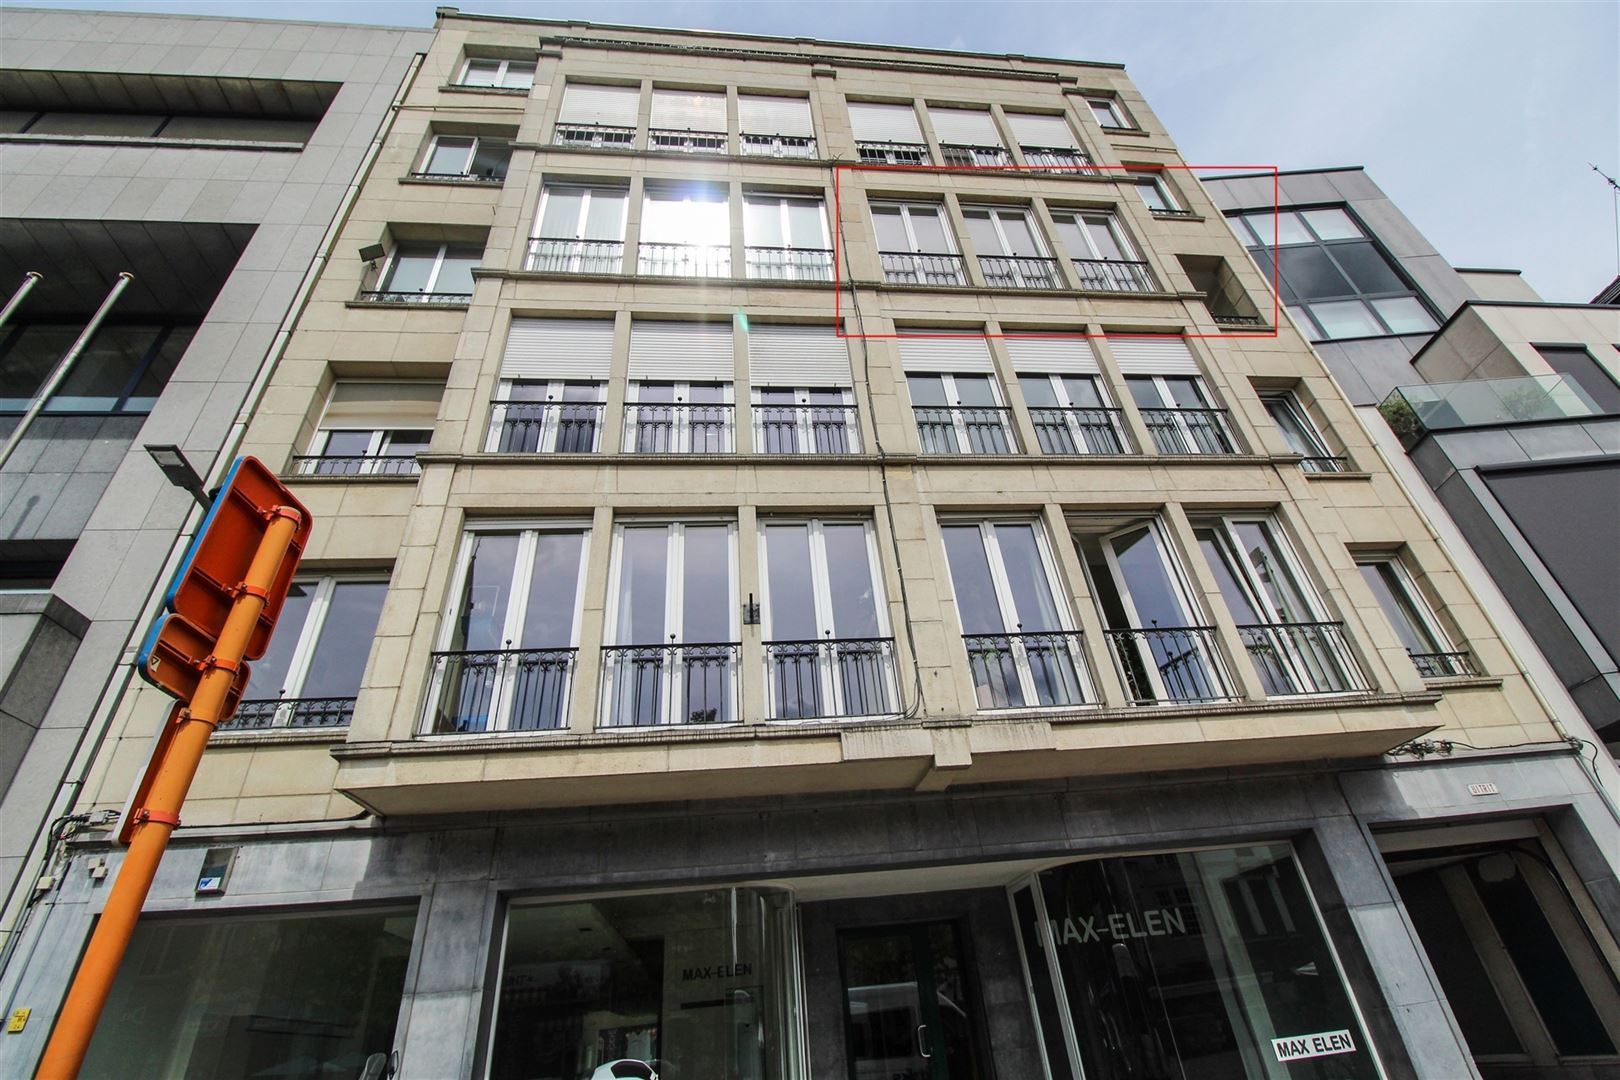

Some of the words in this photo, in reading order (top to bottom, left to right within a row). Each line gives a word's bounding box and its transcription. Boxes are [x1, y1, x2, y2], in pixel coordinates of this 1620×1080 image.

[682, 963, 752, 981] MAX-ELEN
[1276, 1039, 1310, 1058] MAX
[1312, 1034, 1351, 1053] ELEN
